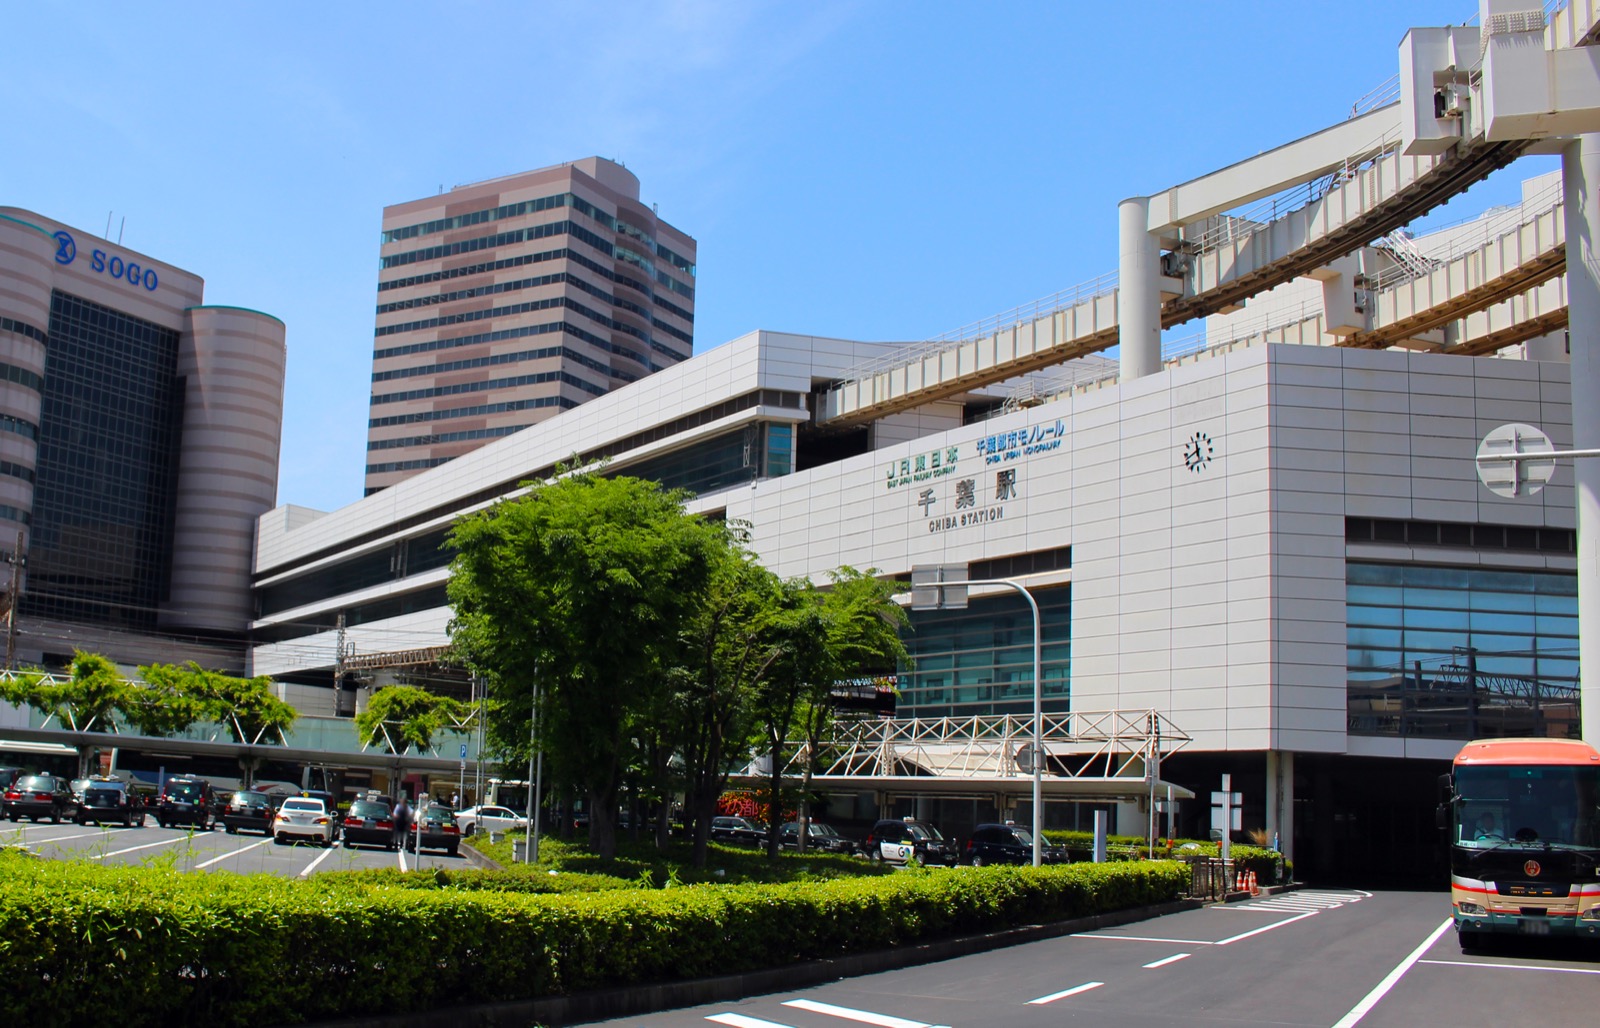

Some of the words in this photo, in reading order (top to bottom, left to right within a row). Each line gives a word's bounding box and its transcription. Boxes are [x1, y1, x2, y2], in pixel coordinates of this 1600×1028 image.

[91, 249, 158, 291] SOGO
[976, 420, 1064, 456] 千葉都市モノレール
[886, 446, 958, 479] JR東日本
[985, 454, 1001, 465] CHIBA
[918, 468, 1016, 517] 千葉駅
[929, 516, 957, 532] CHIBA
[961, 506, 1003, 526] STATION
